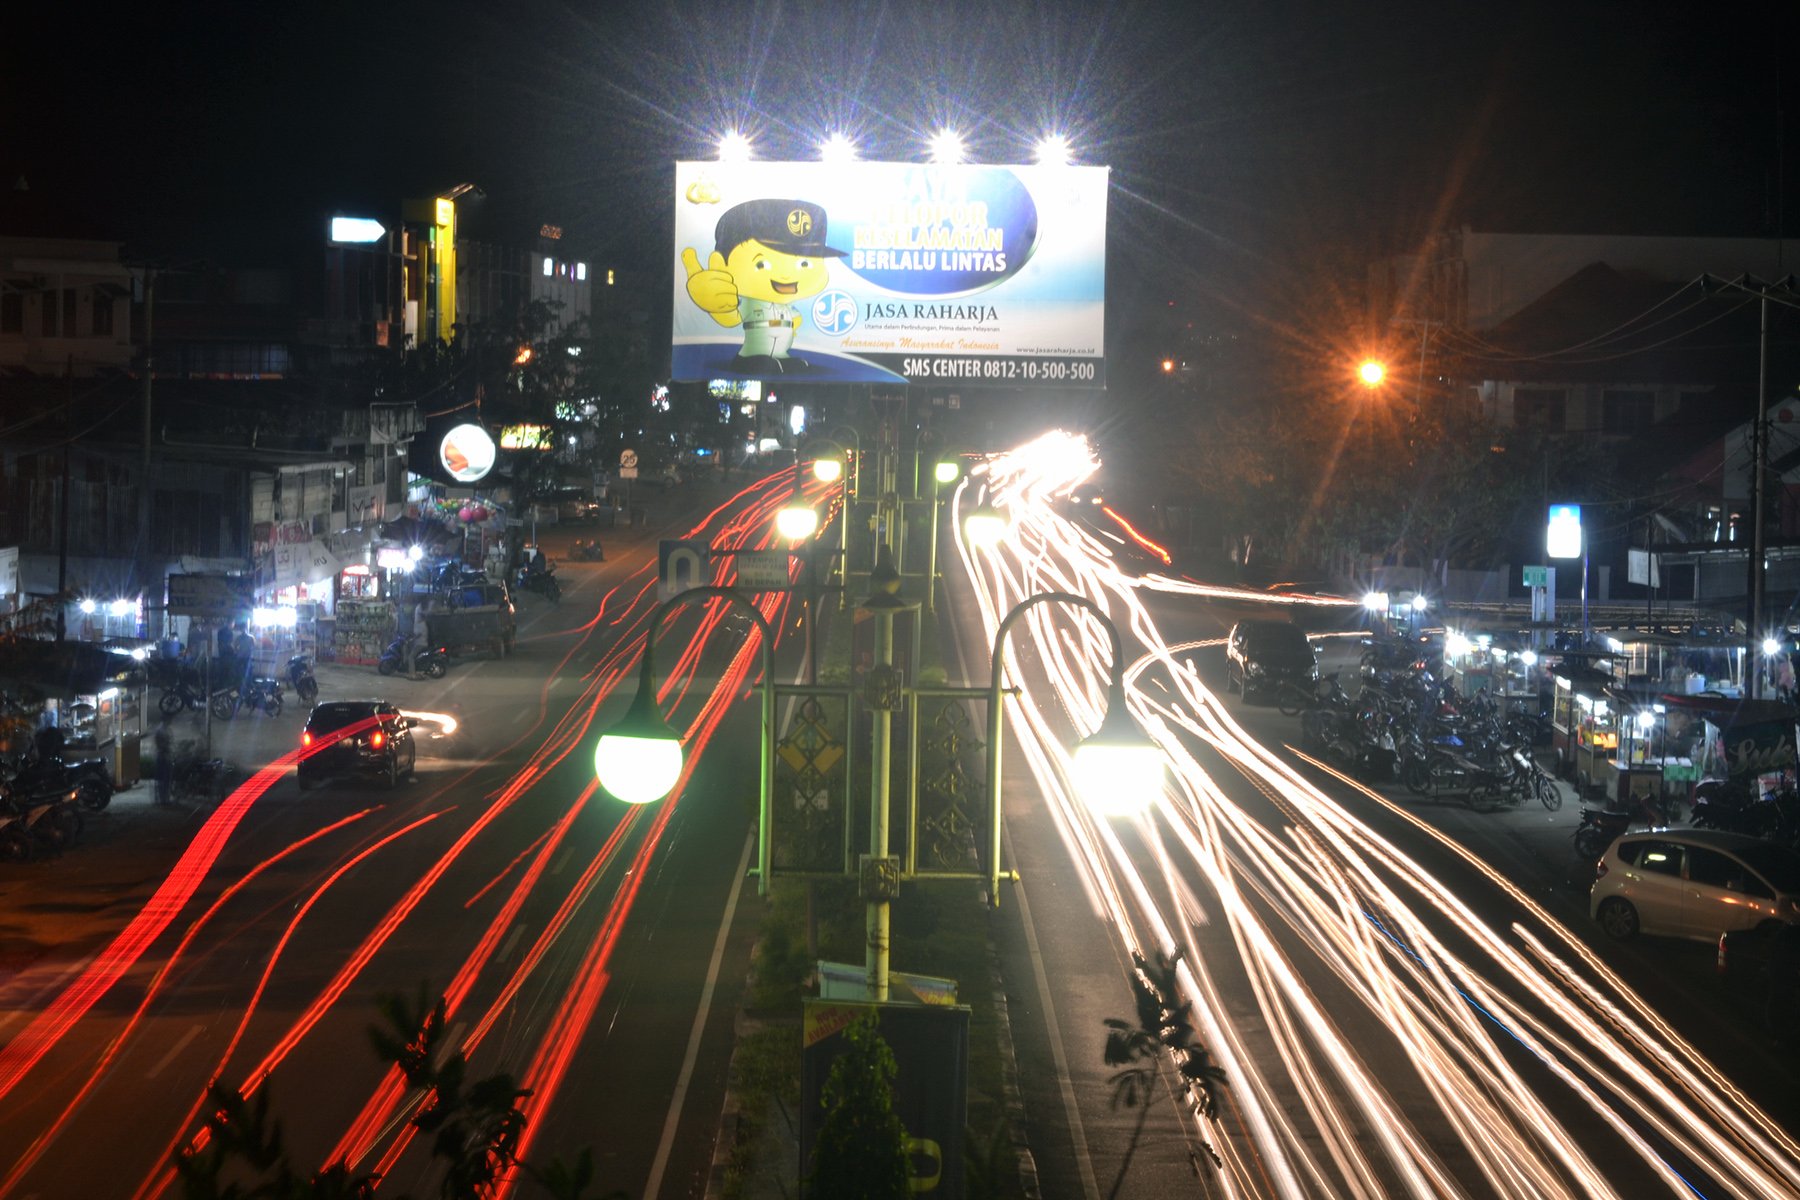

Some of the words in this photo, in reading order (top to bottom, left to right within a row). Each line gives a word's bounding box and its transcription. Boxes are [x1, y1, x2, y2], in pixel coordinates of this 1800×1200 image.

[855, 227, 1003, 250] KESELAMATAN
[852, 250, 936, 270] BERLALU
[941, 252, 1007, 272] LINTAS
[864, 303, 908, 321] JASA
[914, 304, 998, 324] RAHARJA
[903, 357, 931, 377] SMS
[933, 358, 981, 378] CENTER
[984, 360, 1094, 380] 0812-10-500-500
